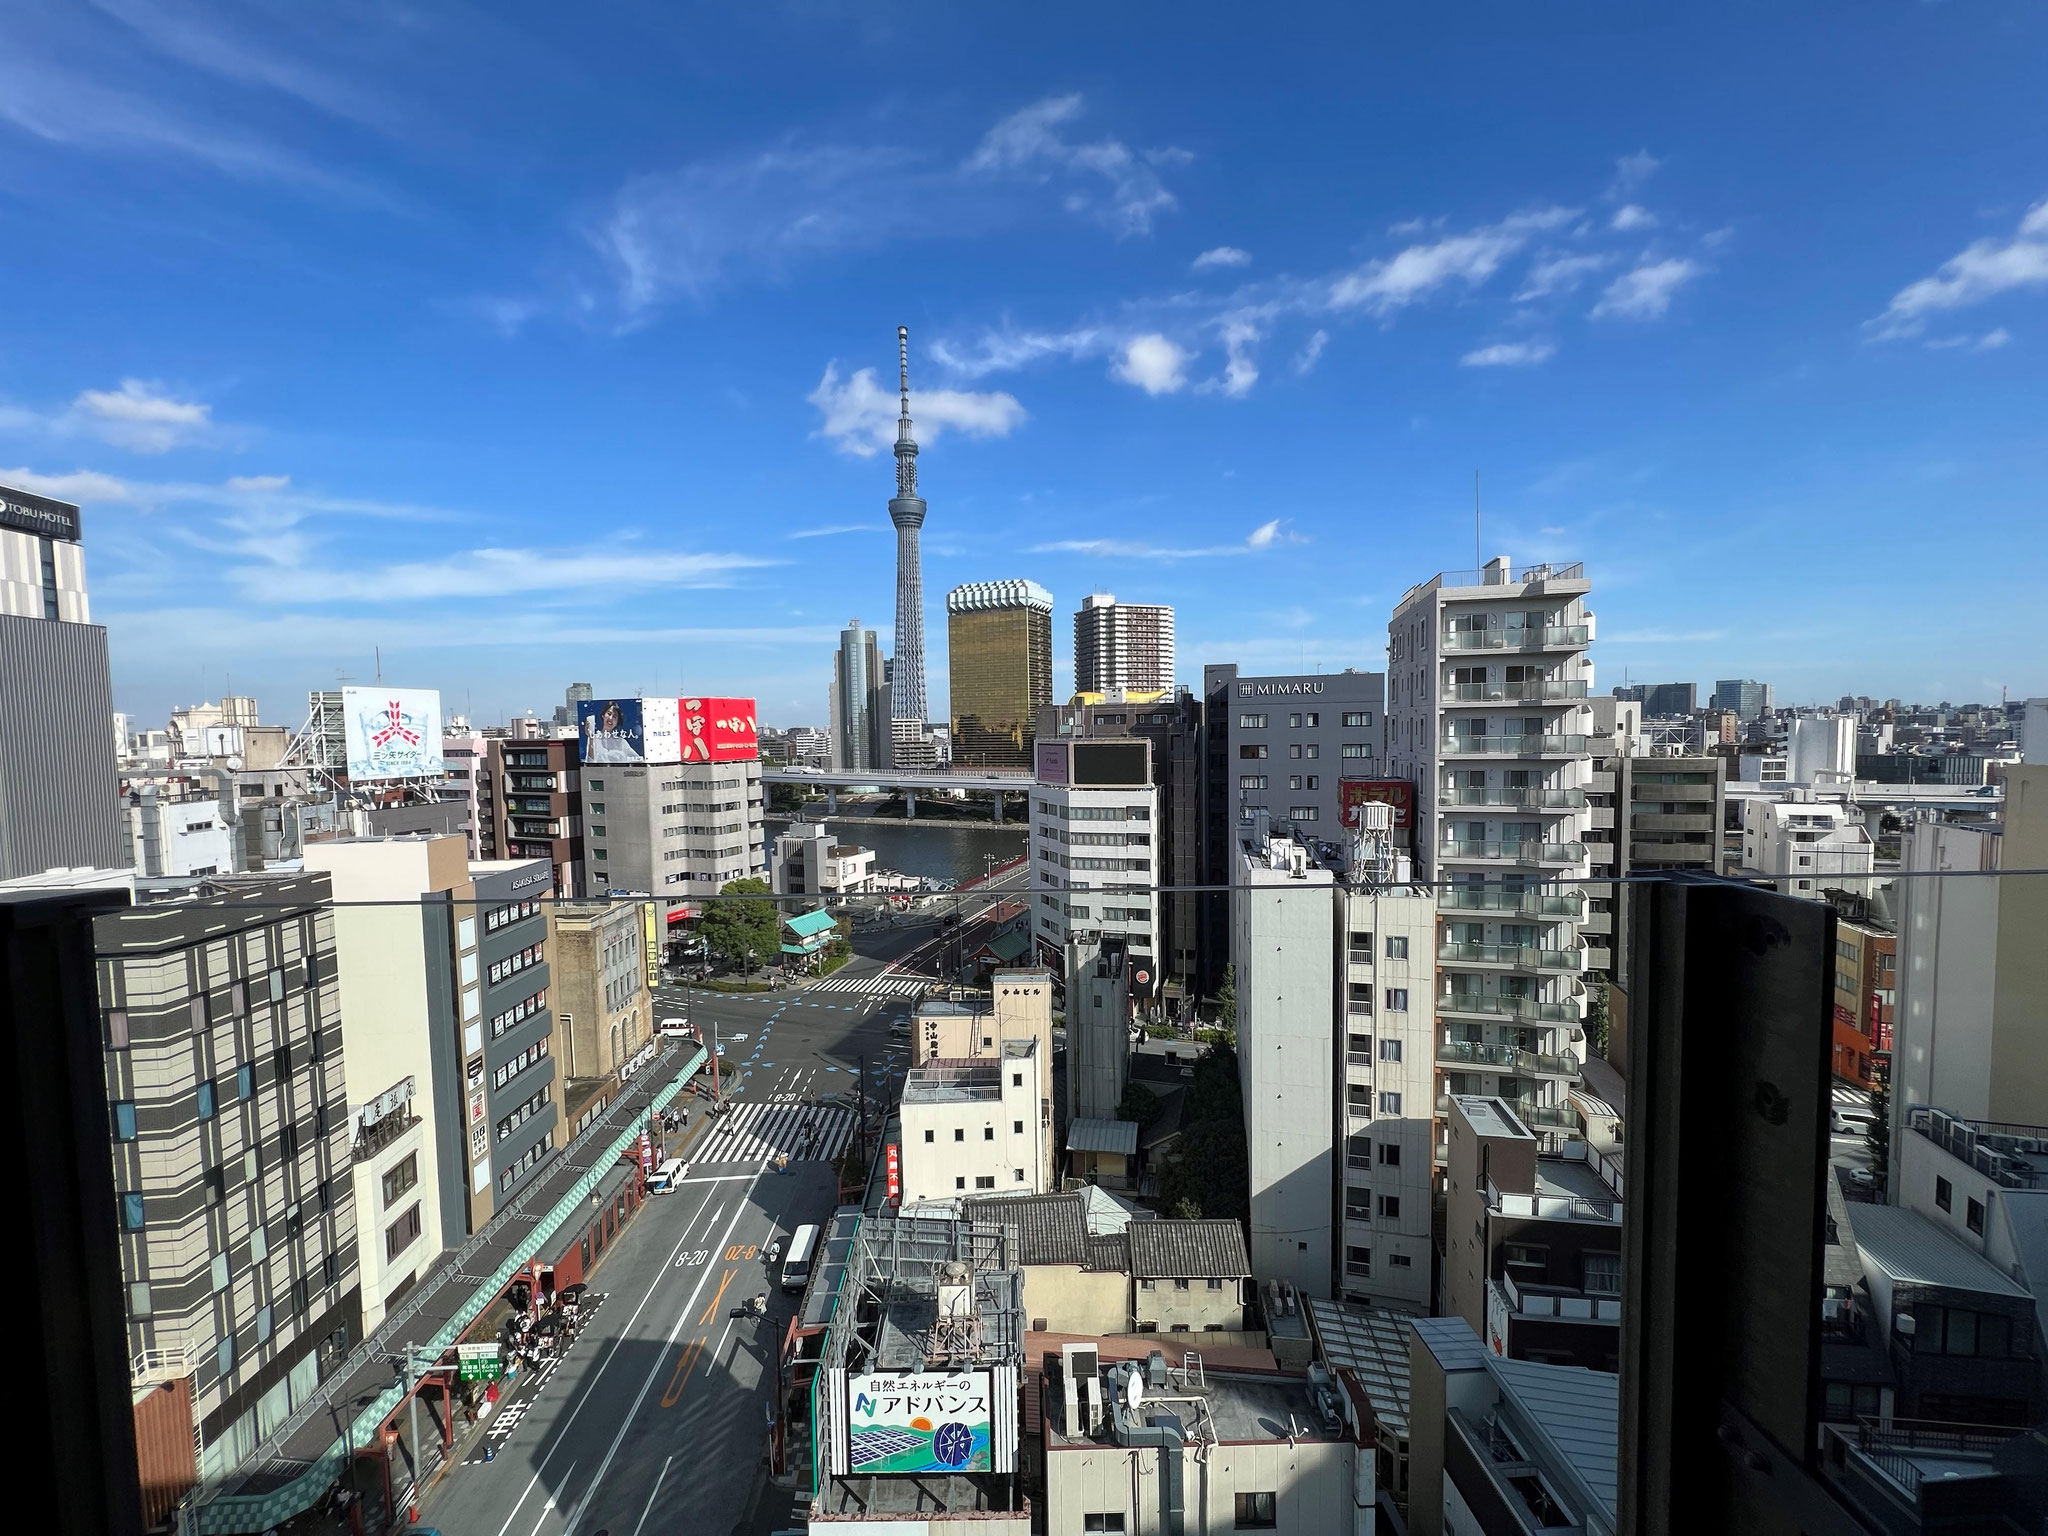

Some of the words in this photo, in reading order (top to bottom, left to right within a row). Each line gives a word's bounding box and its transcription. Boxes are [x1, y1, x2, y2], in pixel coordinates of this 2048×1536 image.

[7, 503, 38, 518] TOBU
[40, 510, 73, 527] HOTEL
[1256, 682, 1324, 695] MIMARU
[1349, 786, 1407, 806] ホテル
[511, 876, 533, 890] ASAKUSA
[532, 870, 549, 883] SQUARE
[1002, 988, 1041, 996] 中山ビル
[773, 1093, 797, 1102] 8-20
[674, 1249, 709, 1268] 8-20
[870, 1379, 971, 1392] 自然エネルギーの
[882, 1394, 987, 1415] アドバンス
